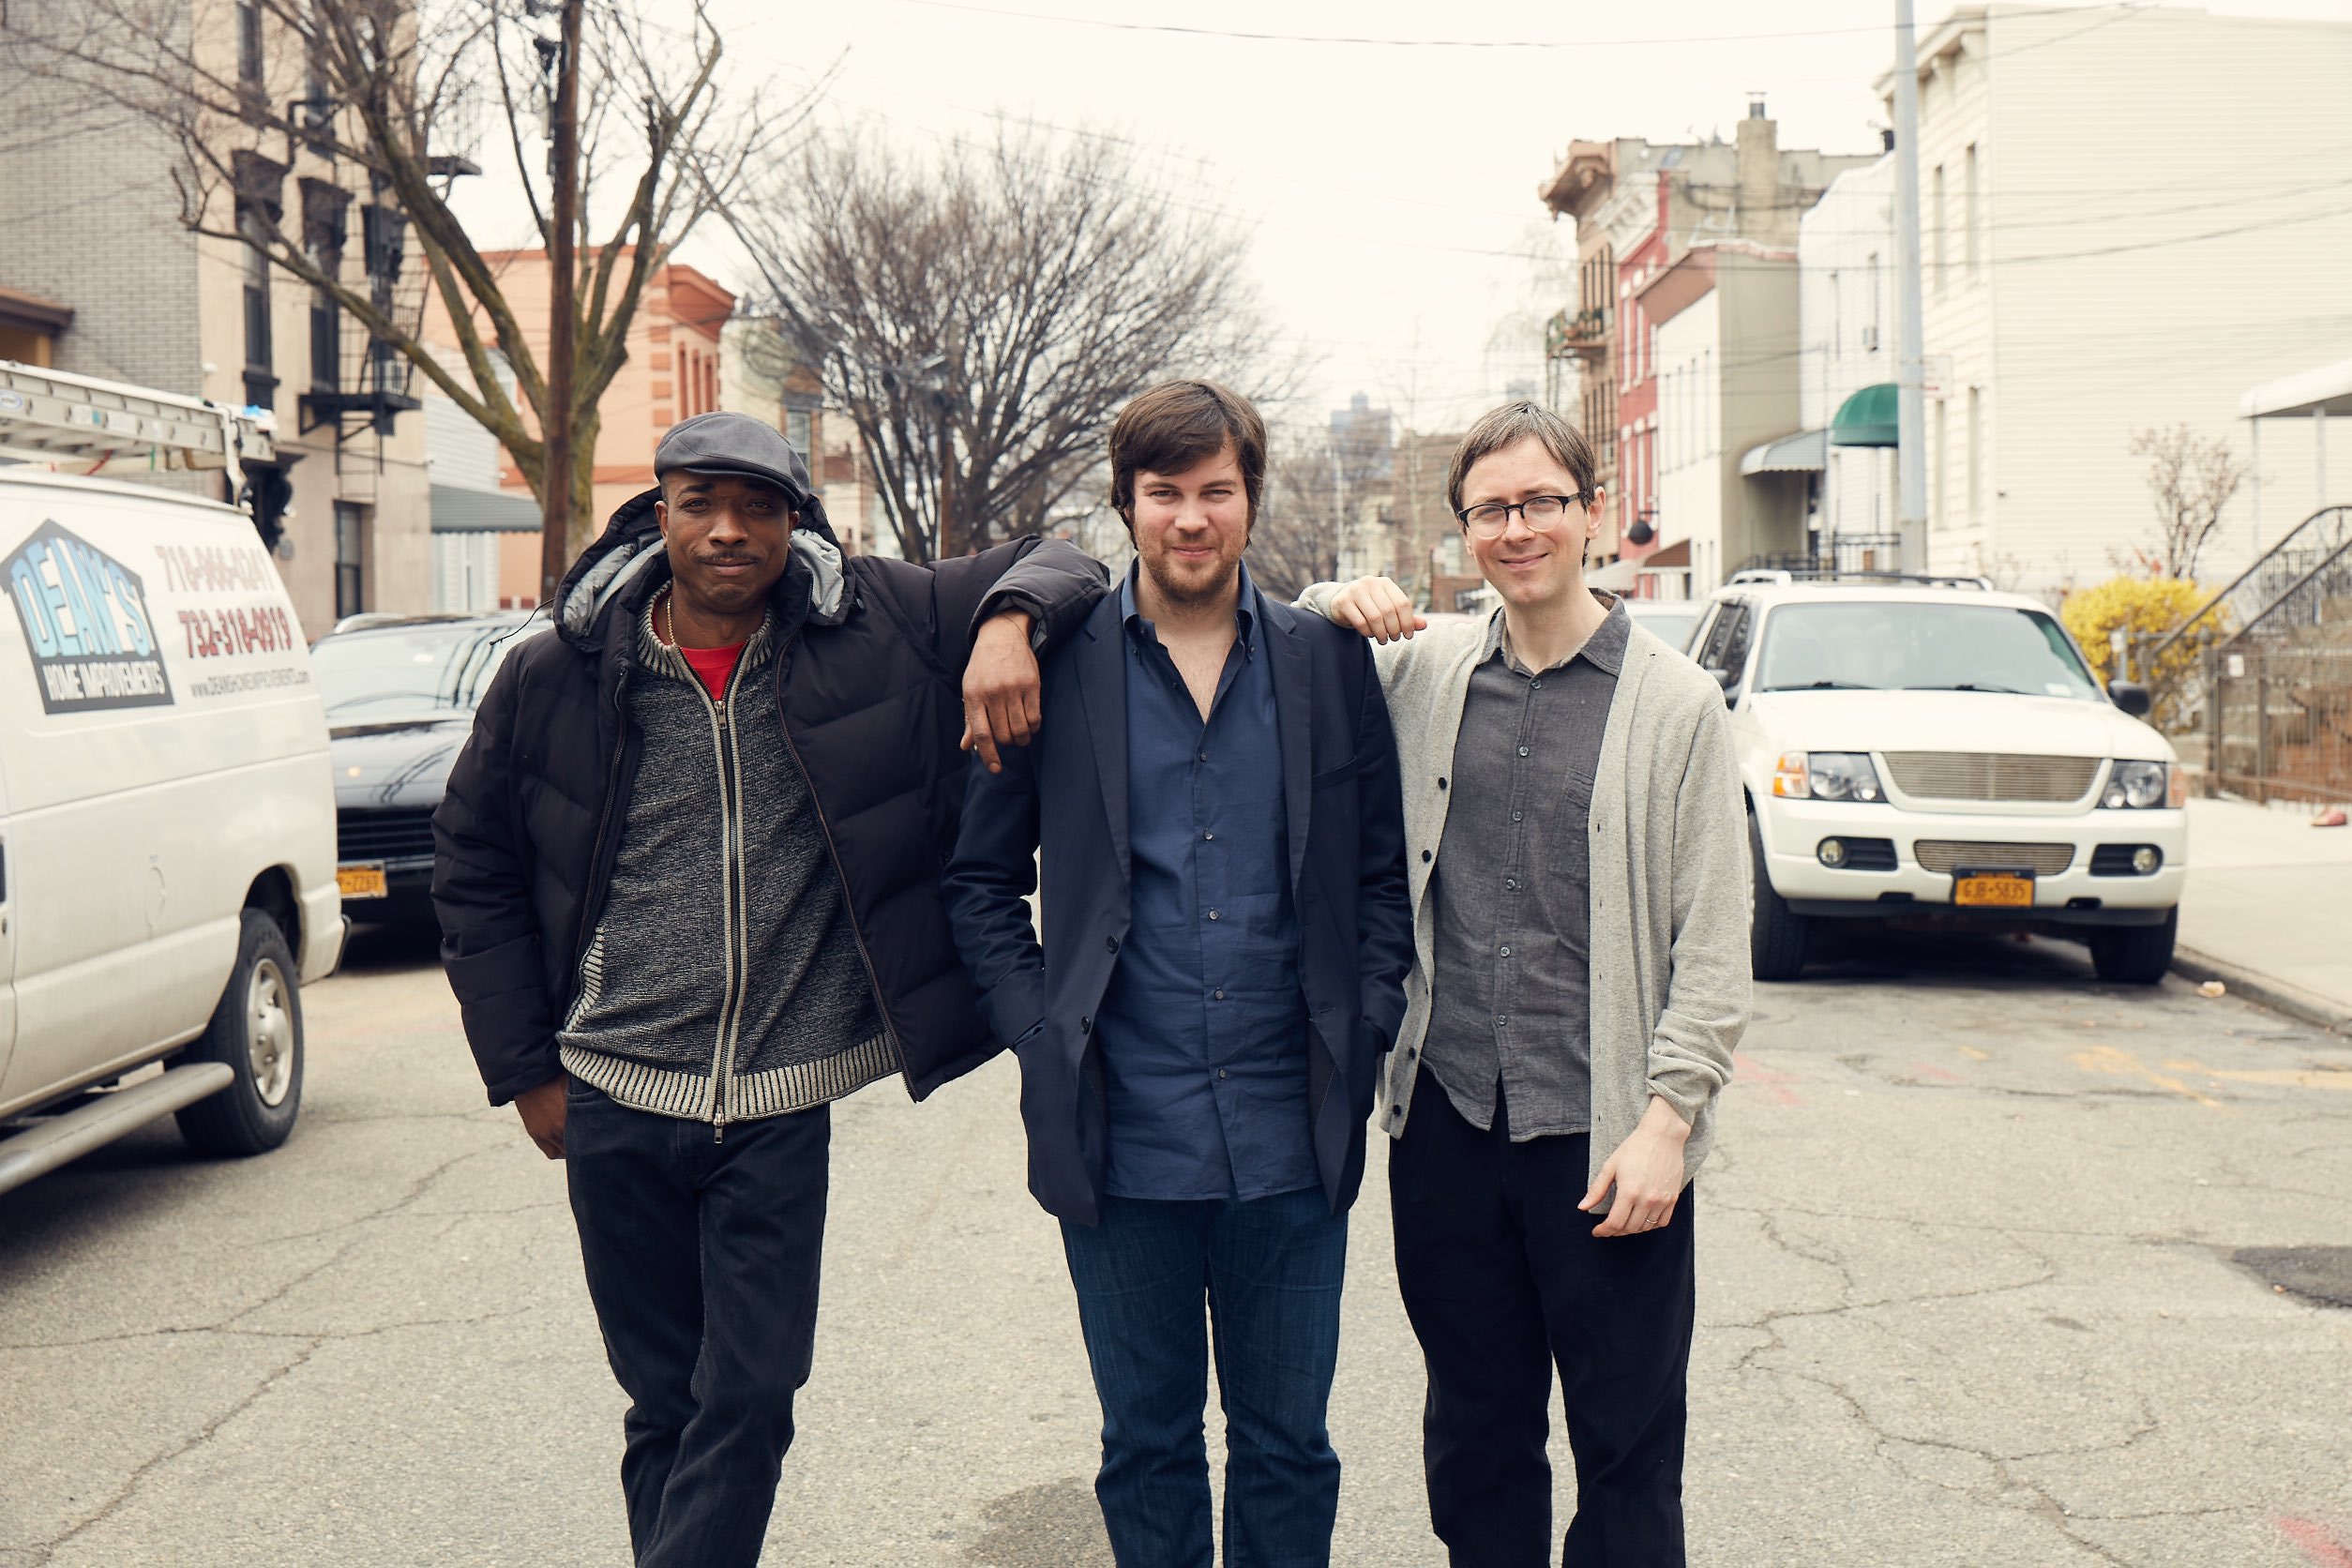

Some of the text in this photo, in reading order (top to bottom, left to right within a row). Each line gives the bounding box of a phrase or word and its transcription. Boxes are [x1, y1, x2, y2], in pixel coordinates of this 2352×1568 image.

[10, 536, 152, 658] DEAN'S
[42, 660, 166, 701] HOME IMPROVEMENTS
